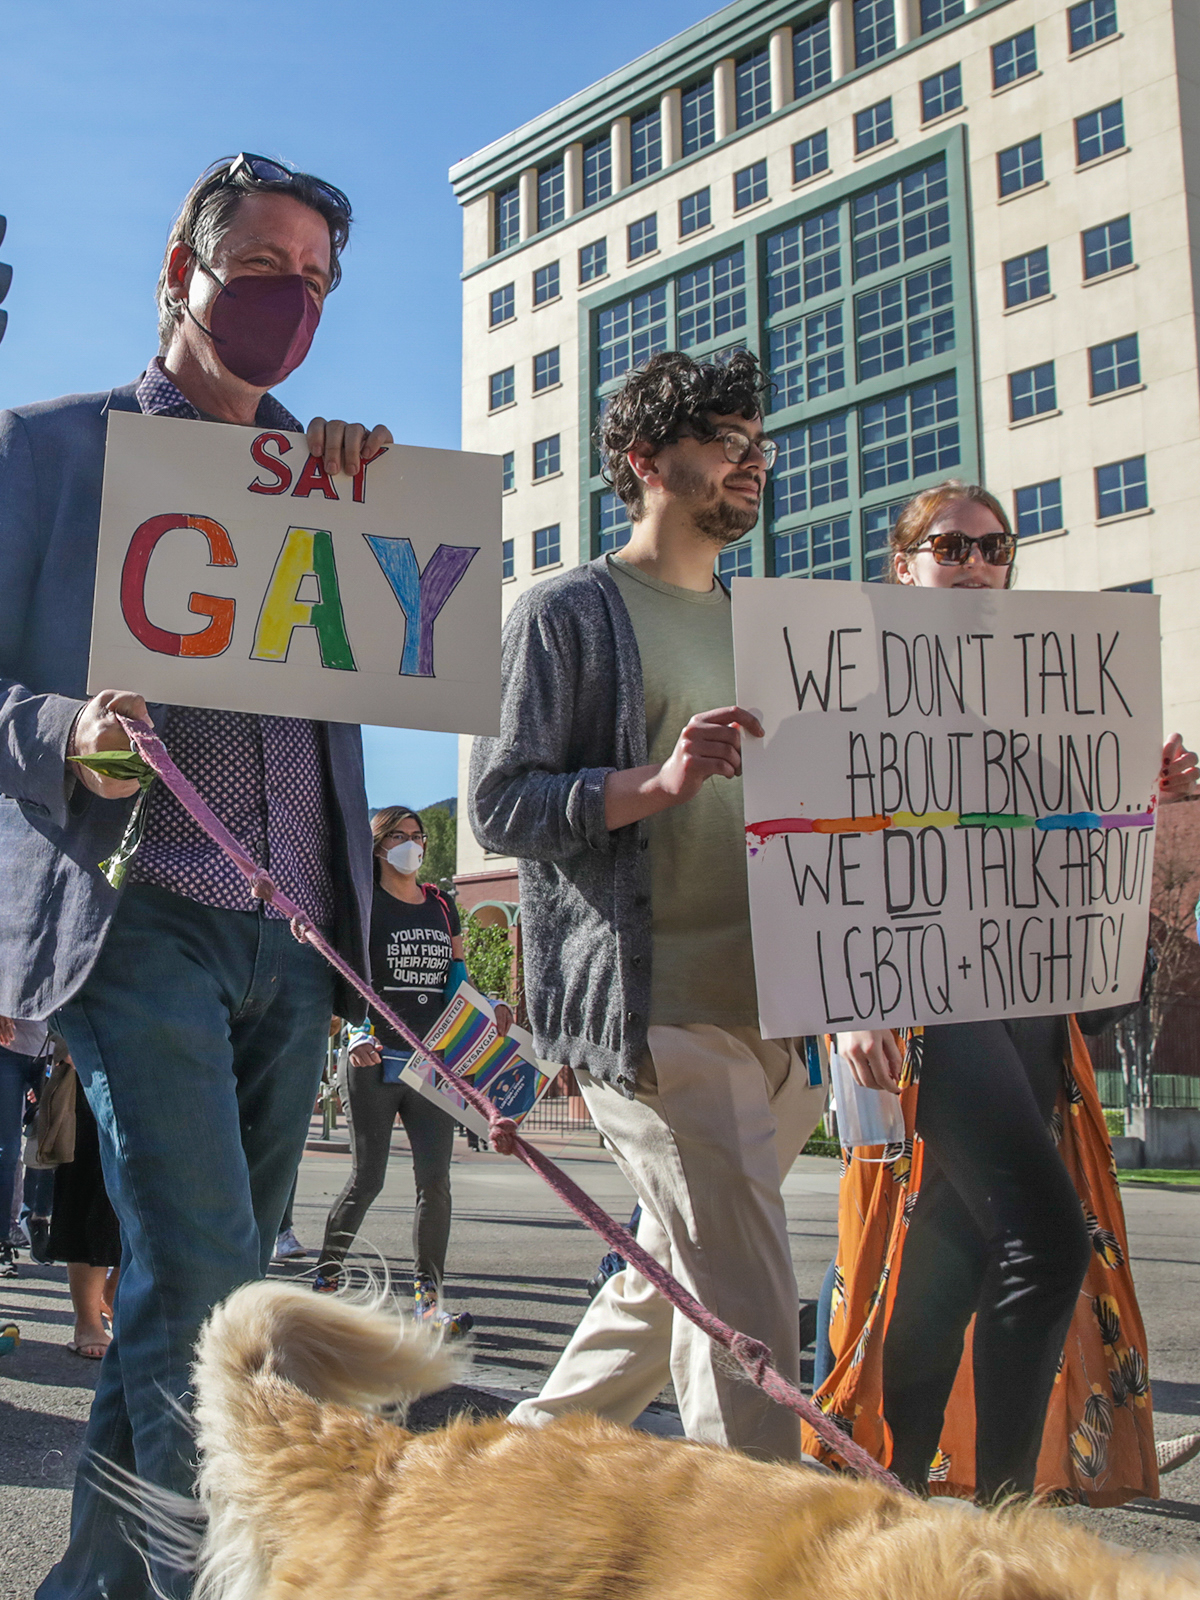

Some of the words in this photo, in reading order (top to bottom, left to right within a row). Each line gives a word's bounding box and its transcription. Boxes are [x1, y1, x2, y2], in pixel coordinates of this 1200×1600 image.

[247, 431, 390, 503] SAY
[120, 513, 481, 678] GAY
[783, 626, 862, 712] WE
[882, 630, 994, 717] DON'T
[1013, 630, 1133, 717] TALK
[846, 730, 974, 821] ABOUT
[784, 832, 864, 906] WE
[882, 825, 947, 914] DO
[954, 824, 1060, 911] TALK
[1060, 826, 1154, 906] ABOUT
[386, 956, 421, 969] THEIR
[420, 957, 448, 970] FIGHT
[387, 944, 400, 956] IS
[401, 944, 419, 956] MY
[421, 944, 449, 958] FIGHT
[391, 928, 425, 943] YOUR
[980, 913, 1125, 1010] RIGHTS!
[393, 968, 418, 984] OUR
[413, 999, 464, 1069] #DIEYDOBETTER
[445, 1028, 497, 1088] #SNEYSAYGAY
